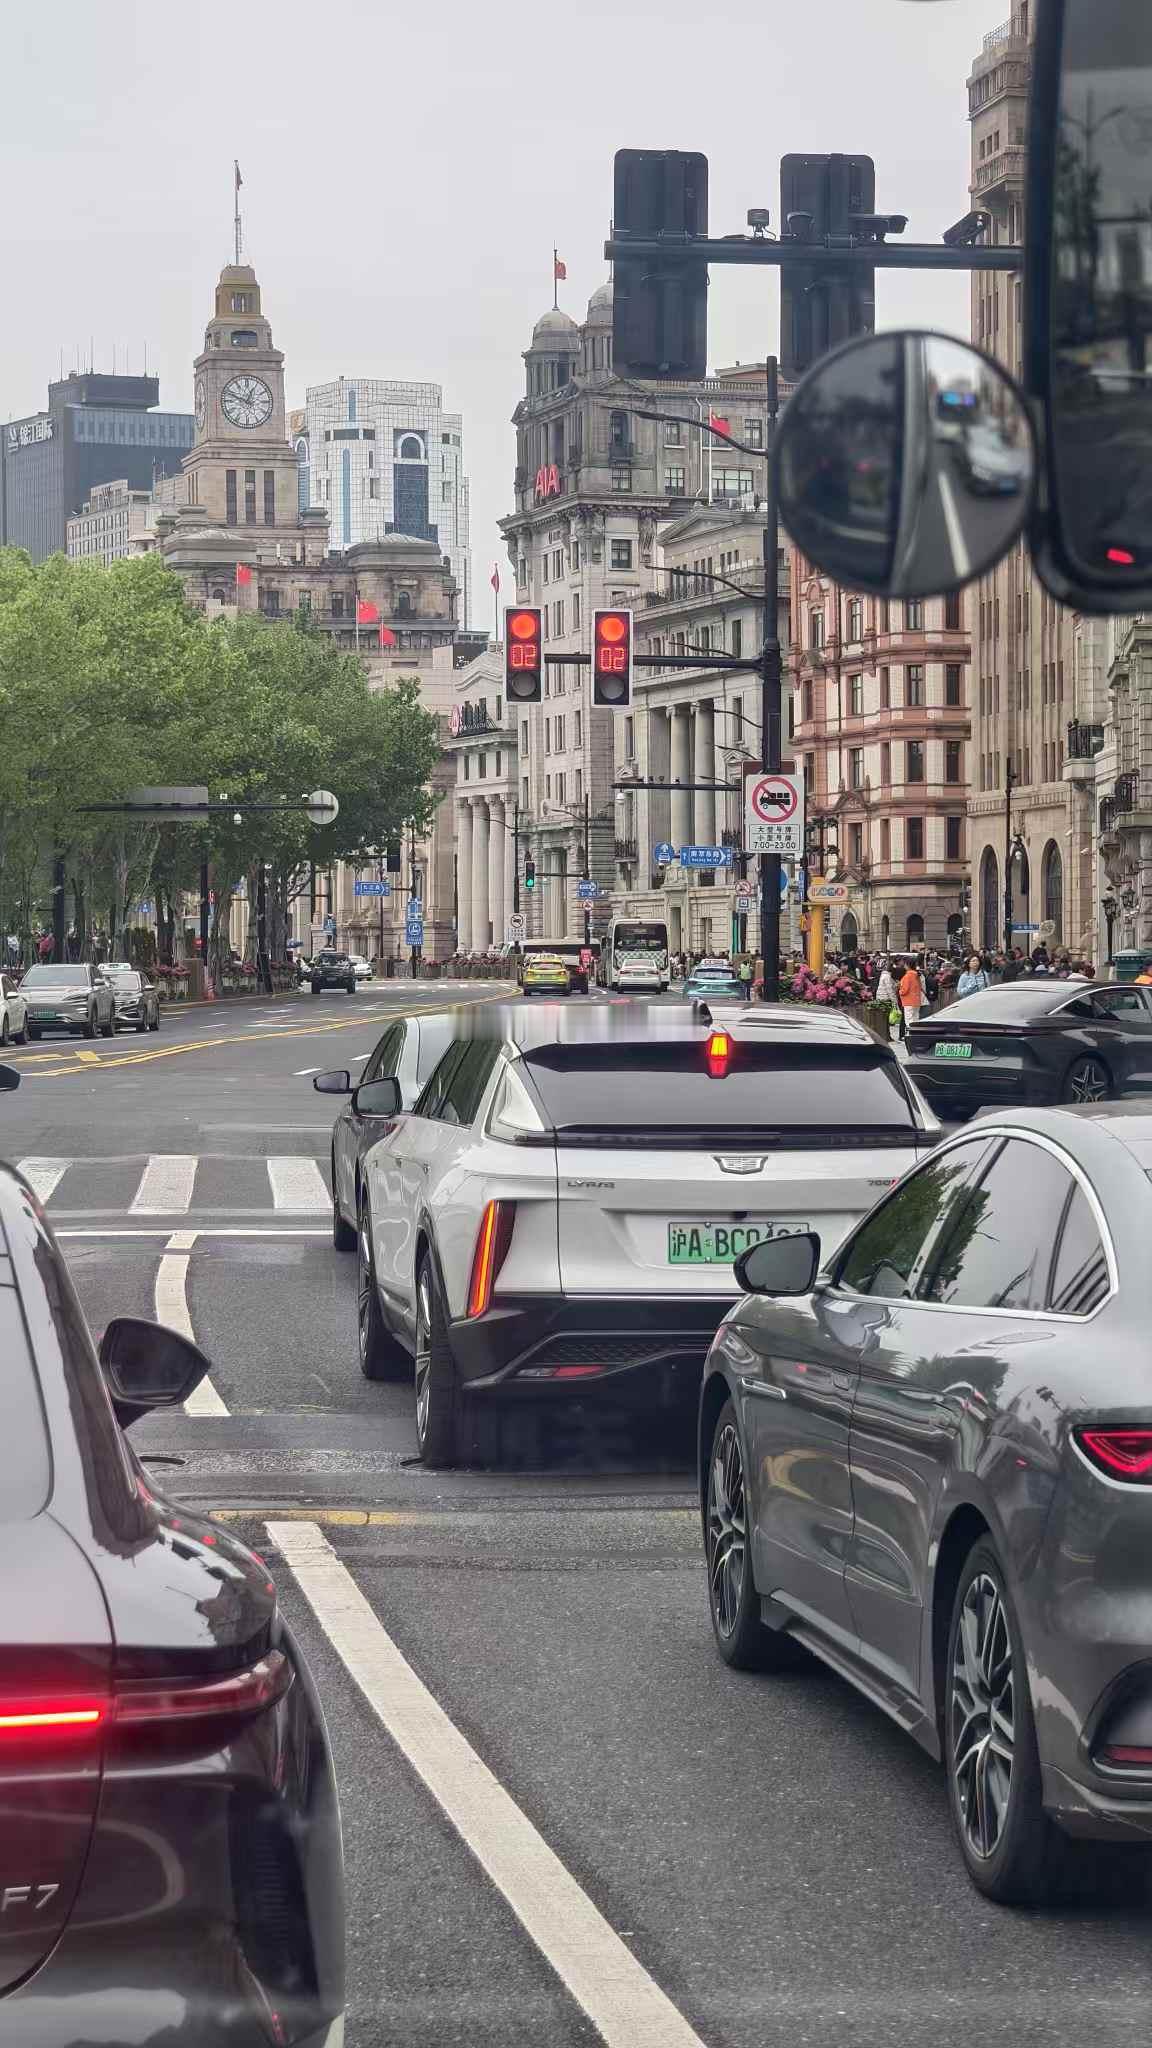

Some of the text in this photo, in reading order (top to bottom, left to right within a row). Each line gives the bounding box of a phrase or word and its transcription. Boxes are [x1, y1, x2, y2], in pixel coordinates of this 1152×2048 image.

[535, 464, 560, 499] AIA
[511, 644, 537, 667] 02
[600, 647, 625, 671] 02
[1, 1883, 60, 1912] F7
